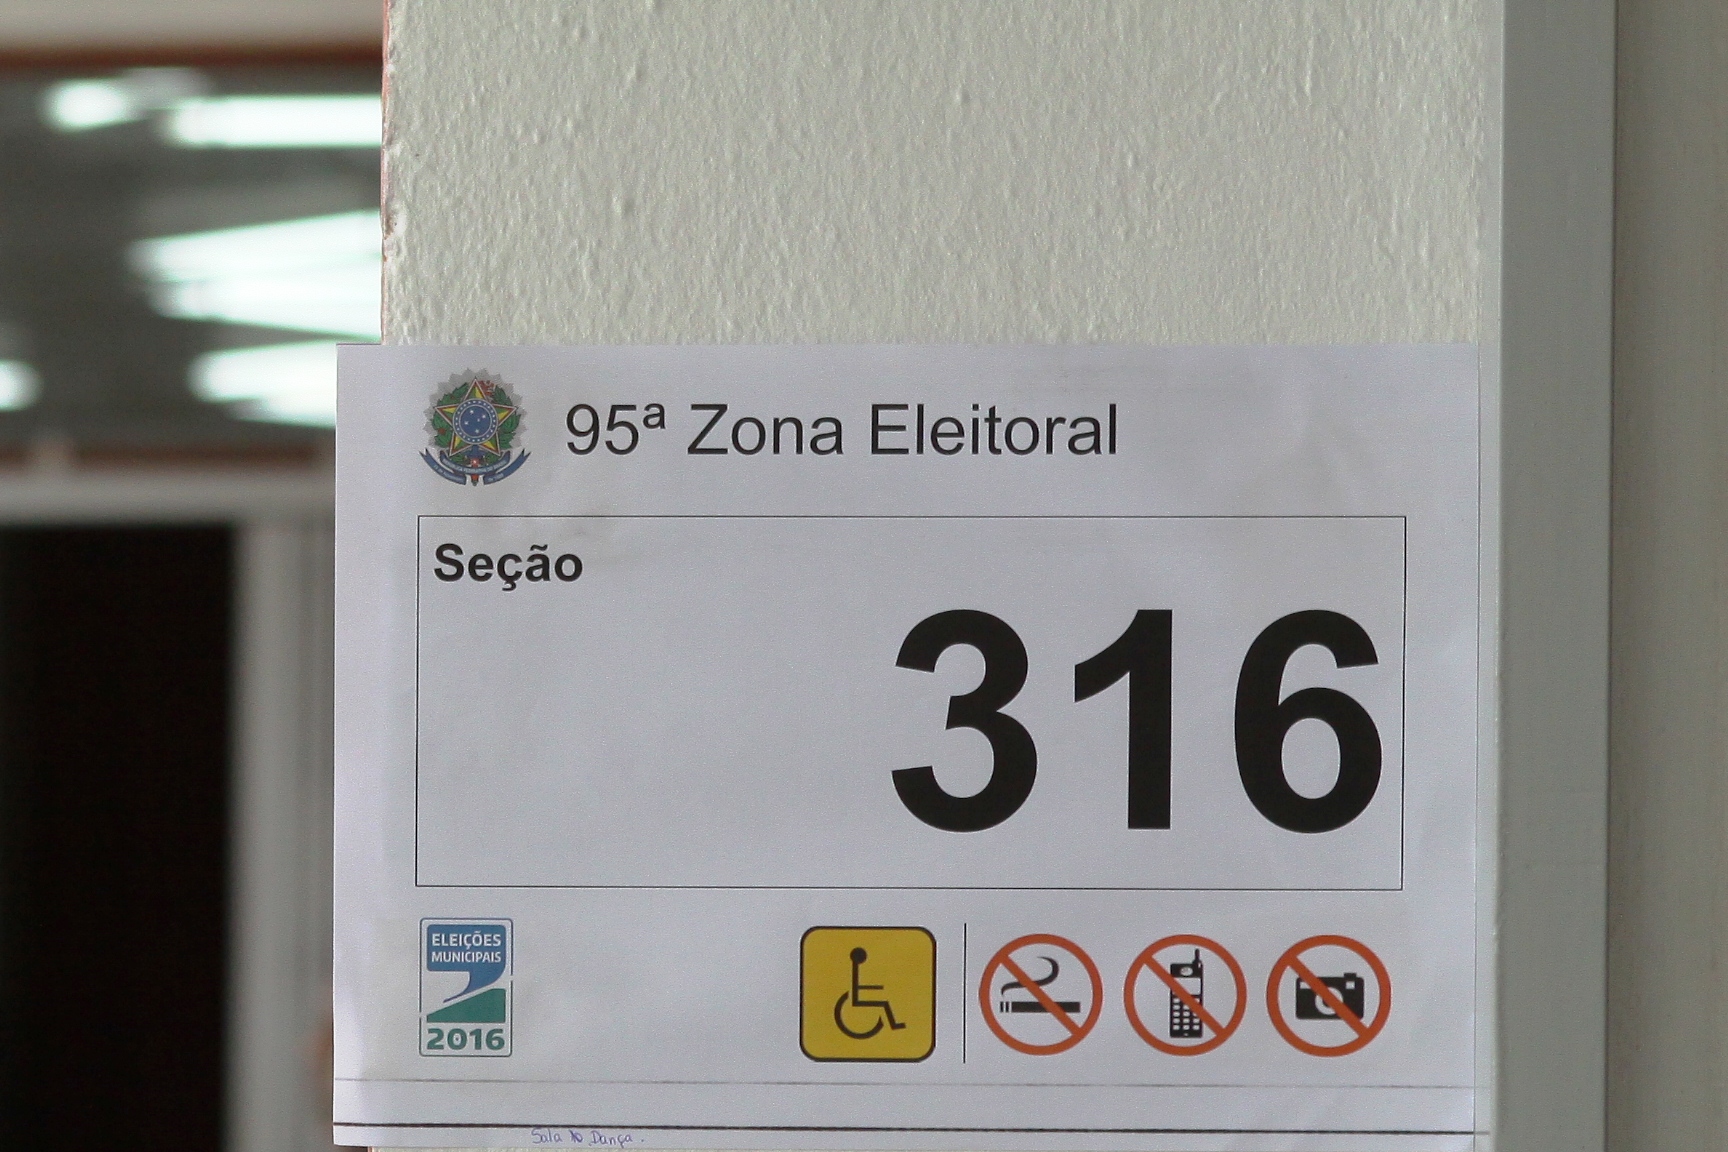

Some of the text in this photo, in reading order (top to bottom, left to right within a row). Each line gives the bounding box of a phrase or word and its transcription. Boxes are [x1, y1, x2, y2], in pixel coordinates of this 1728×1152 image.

[566, 402, 1117, 456] 95ª Zona Eleitoral
[433, 542, 584, 592] Seção
[891, 608, 1383, 834] 316
[430, 951, 502, 963] MUNICIPAIS
[431, 930, 502, 950] ELEIÇÕES
[426, 1027, 506, 1051] 2016
